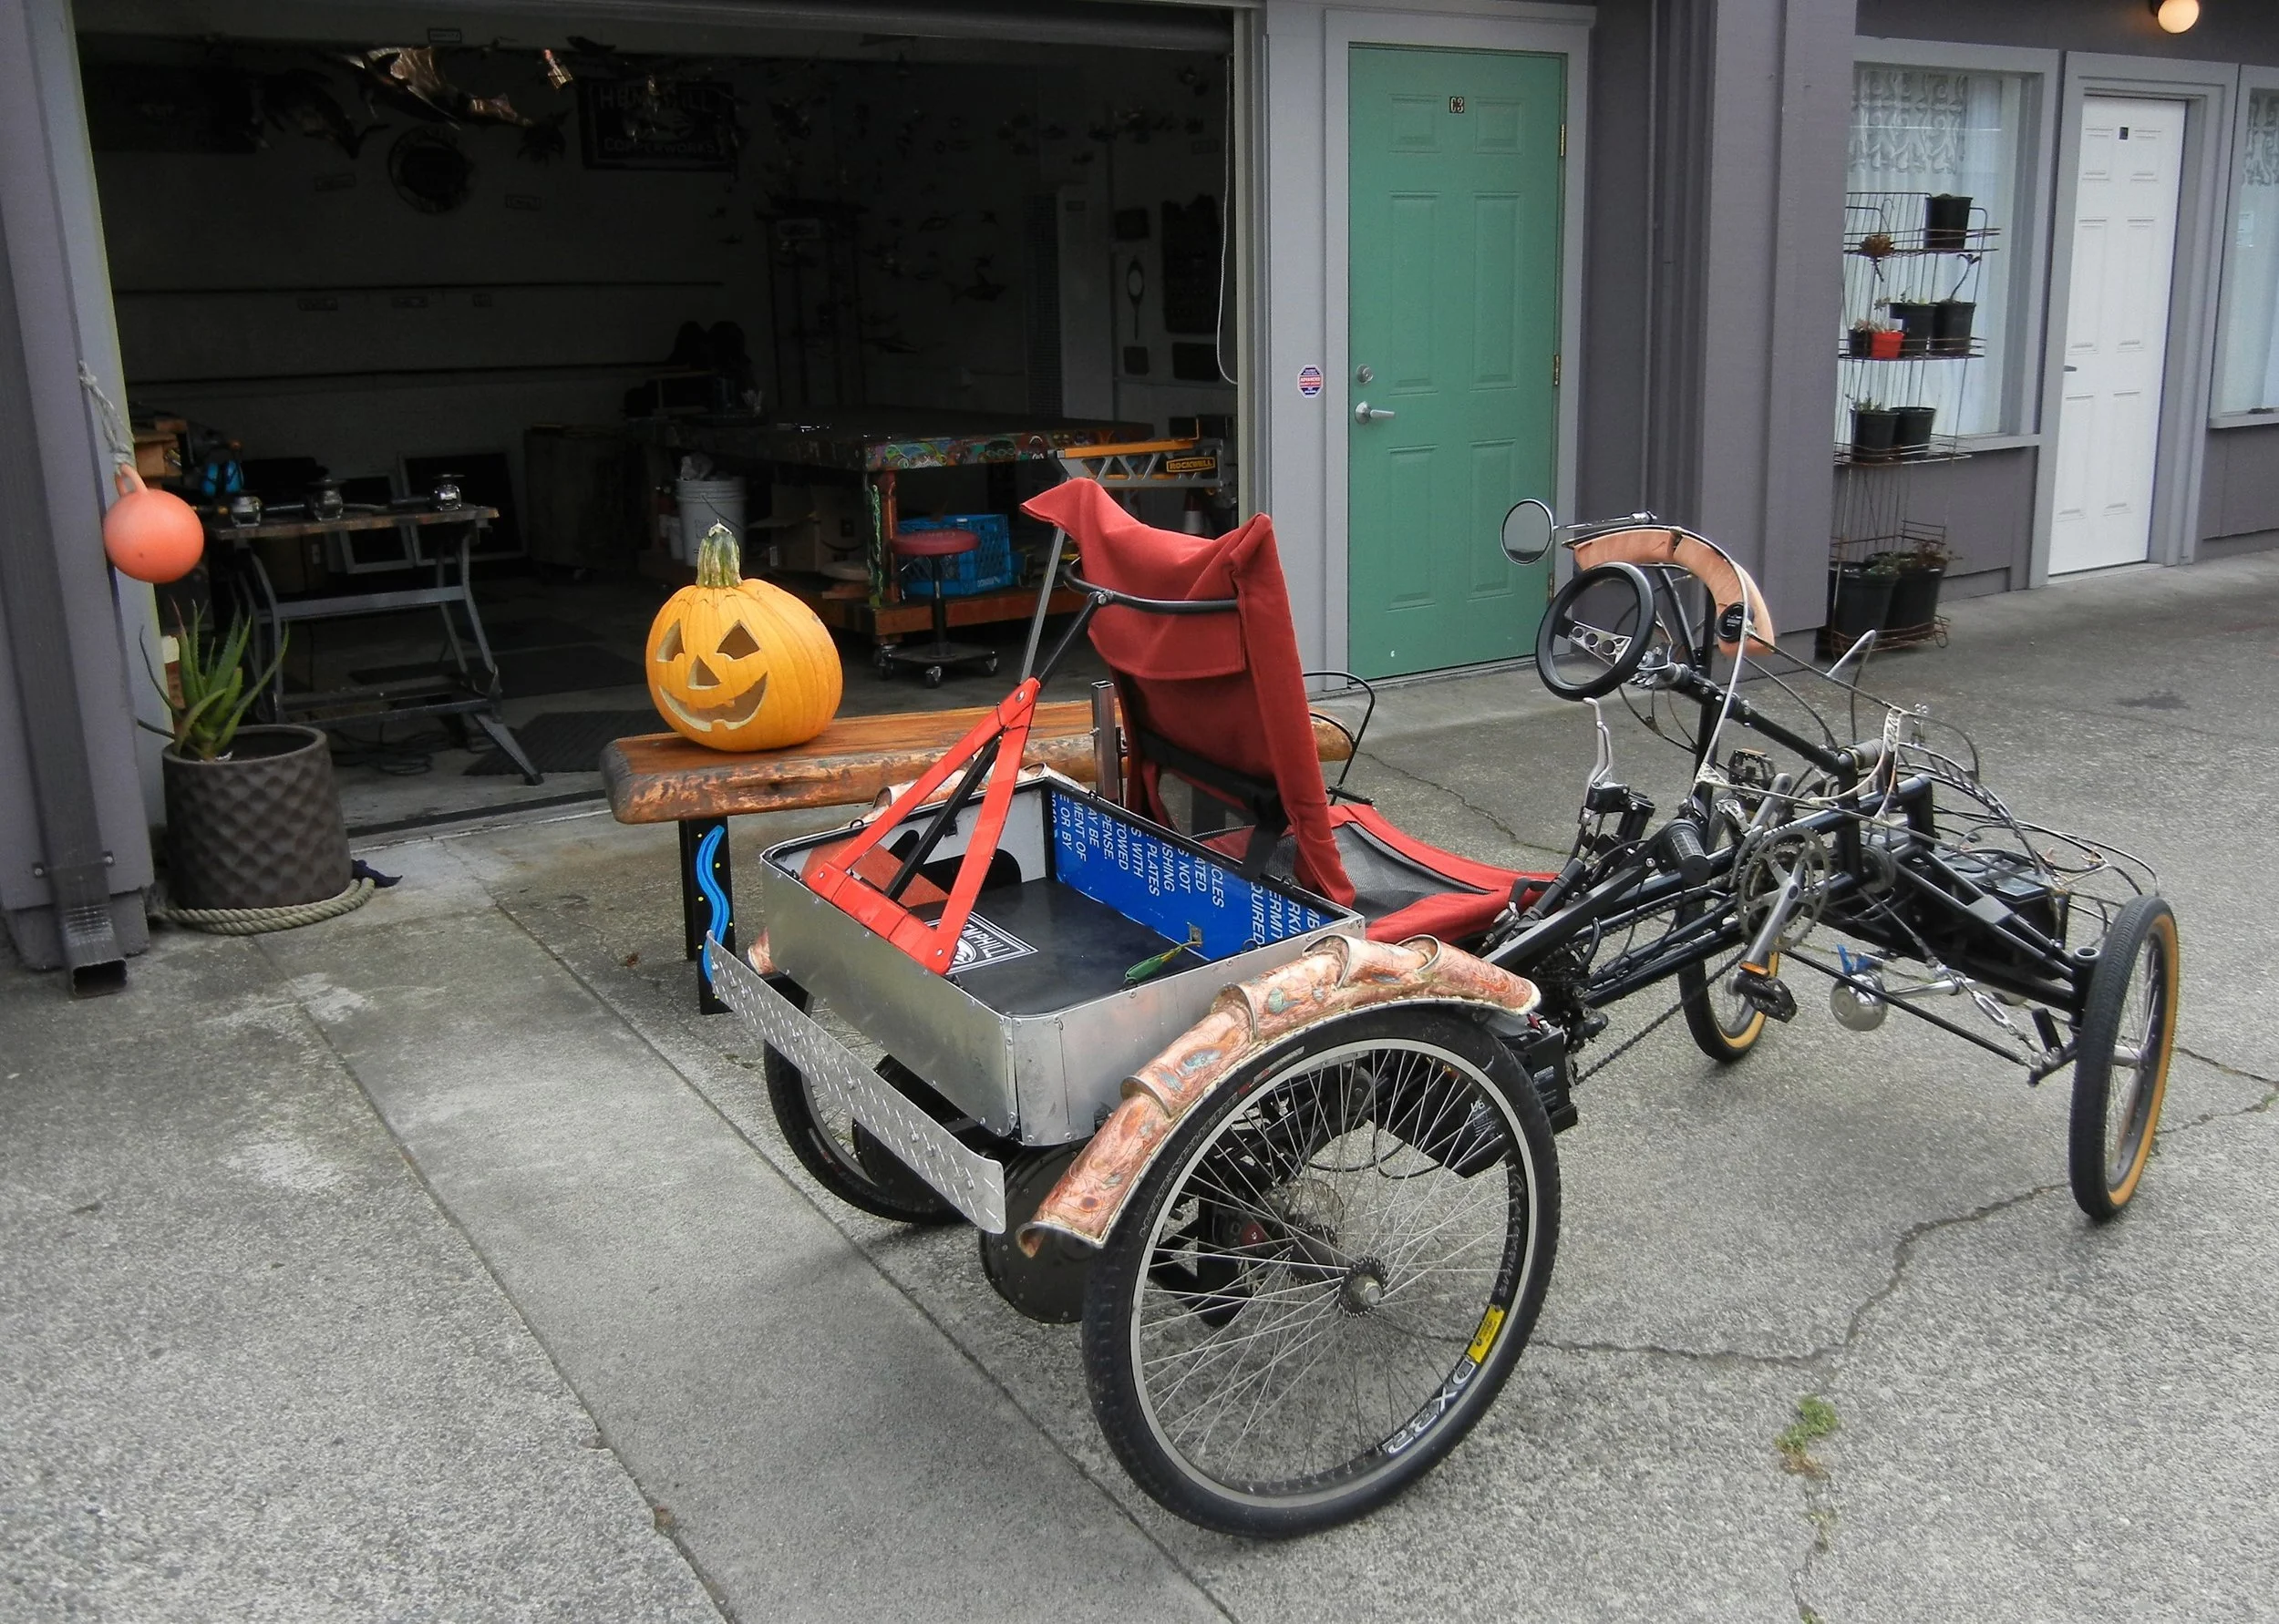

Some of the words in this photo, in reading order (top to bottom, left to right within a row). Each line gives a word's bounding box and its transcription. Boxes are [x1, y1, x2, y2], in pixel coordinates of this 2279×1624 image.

[1170, 458, 1212, 470] ROCKWELL
[1060, 807, 1071, 827] OR
[1087, 807, 1098, 826] AY
[1061, 830, 1073, 851] BY
[1076, 841, 1087, 862] OF
[1088, 827, 1100, 848] BE
[1101, 813, 1114, 859] PENSE.
[1116, 822, 1129, 870] TOWED
[1131, 842, 1144, 879] WITH
[1146, 842, 1160, 897] PLATES
[1161, 842, 1175, 892] ISHING
[1178, 859, 1191, 894] NOT
[1381, 1355, 1478, 1454] DX32
